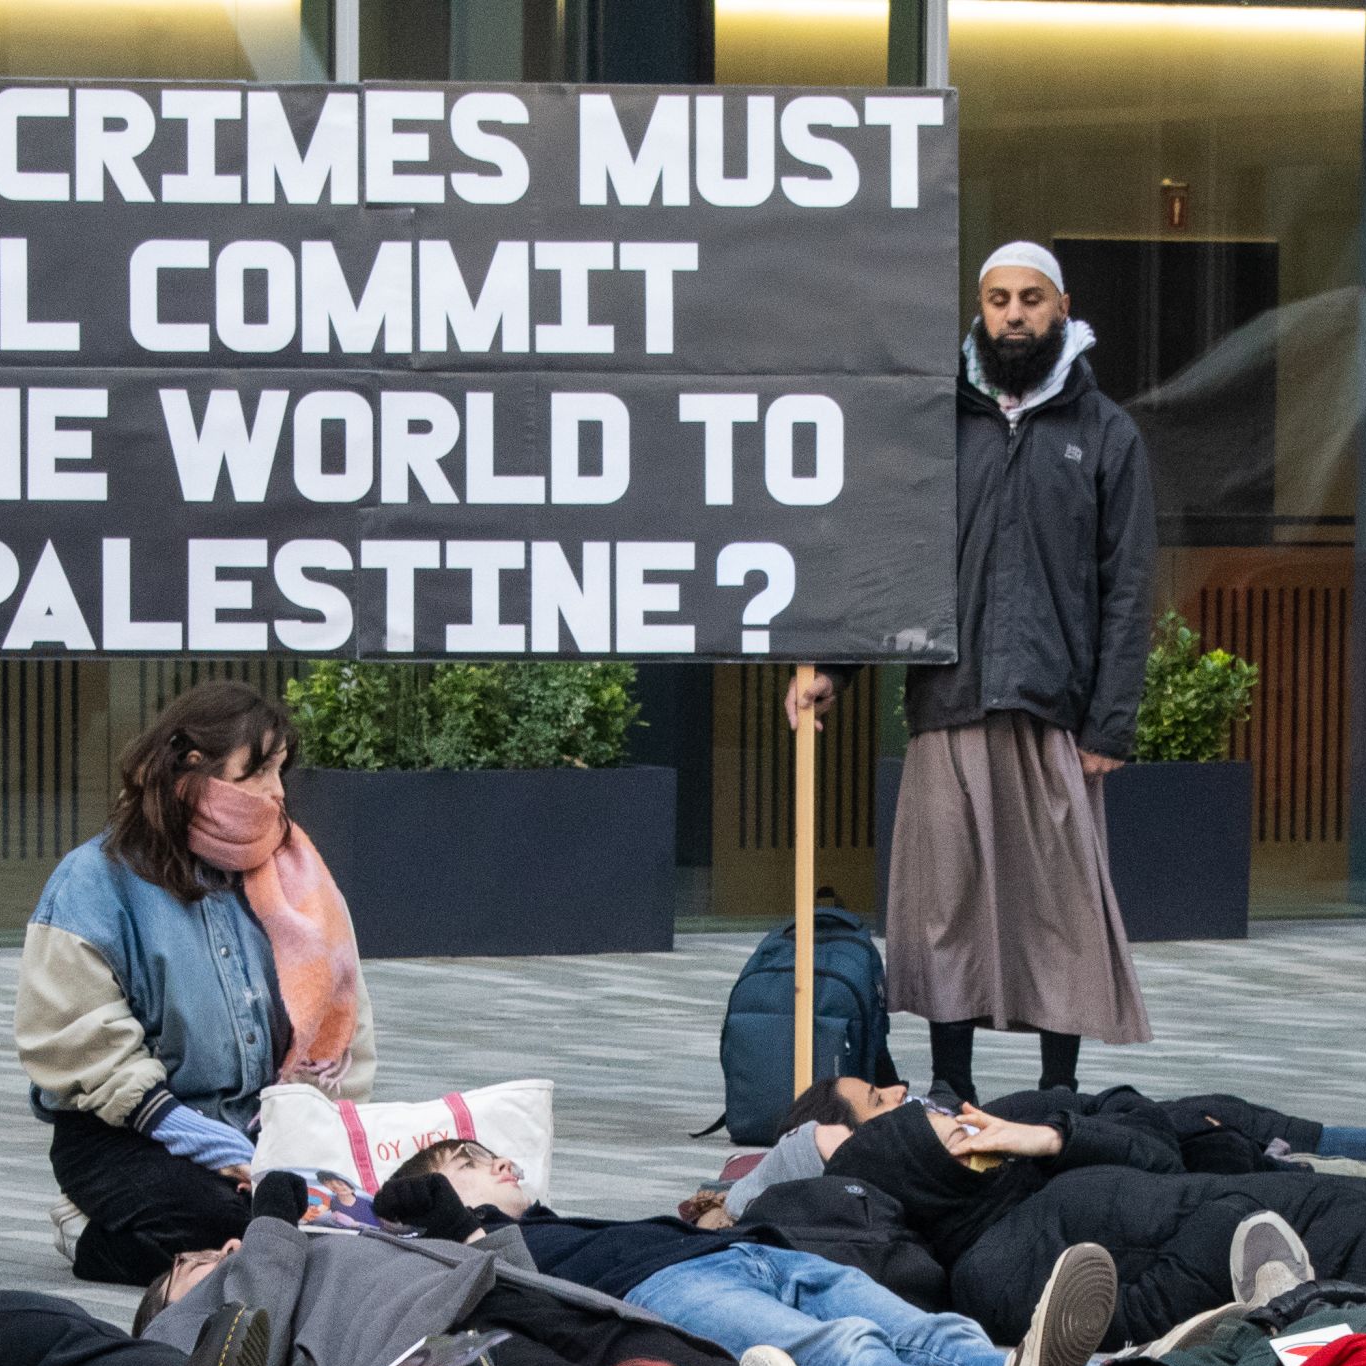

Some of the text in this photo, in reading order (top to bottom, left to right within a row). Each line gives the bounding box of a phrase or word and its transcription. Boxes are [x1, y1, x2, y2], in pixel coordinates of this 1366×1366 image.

[579, 93, 944, 209] MUST
[129, 239, 699, 355] COMMIT
[158, 388, 630, 506] WORLD
[679, 393, 844, 507] TO
[377, 1140, 401, 1161] OY
